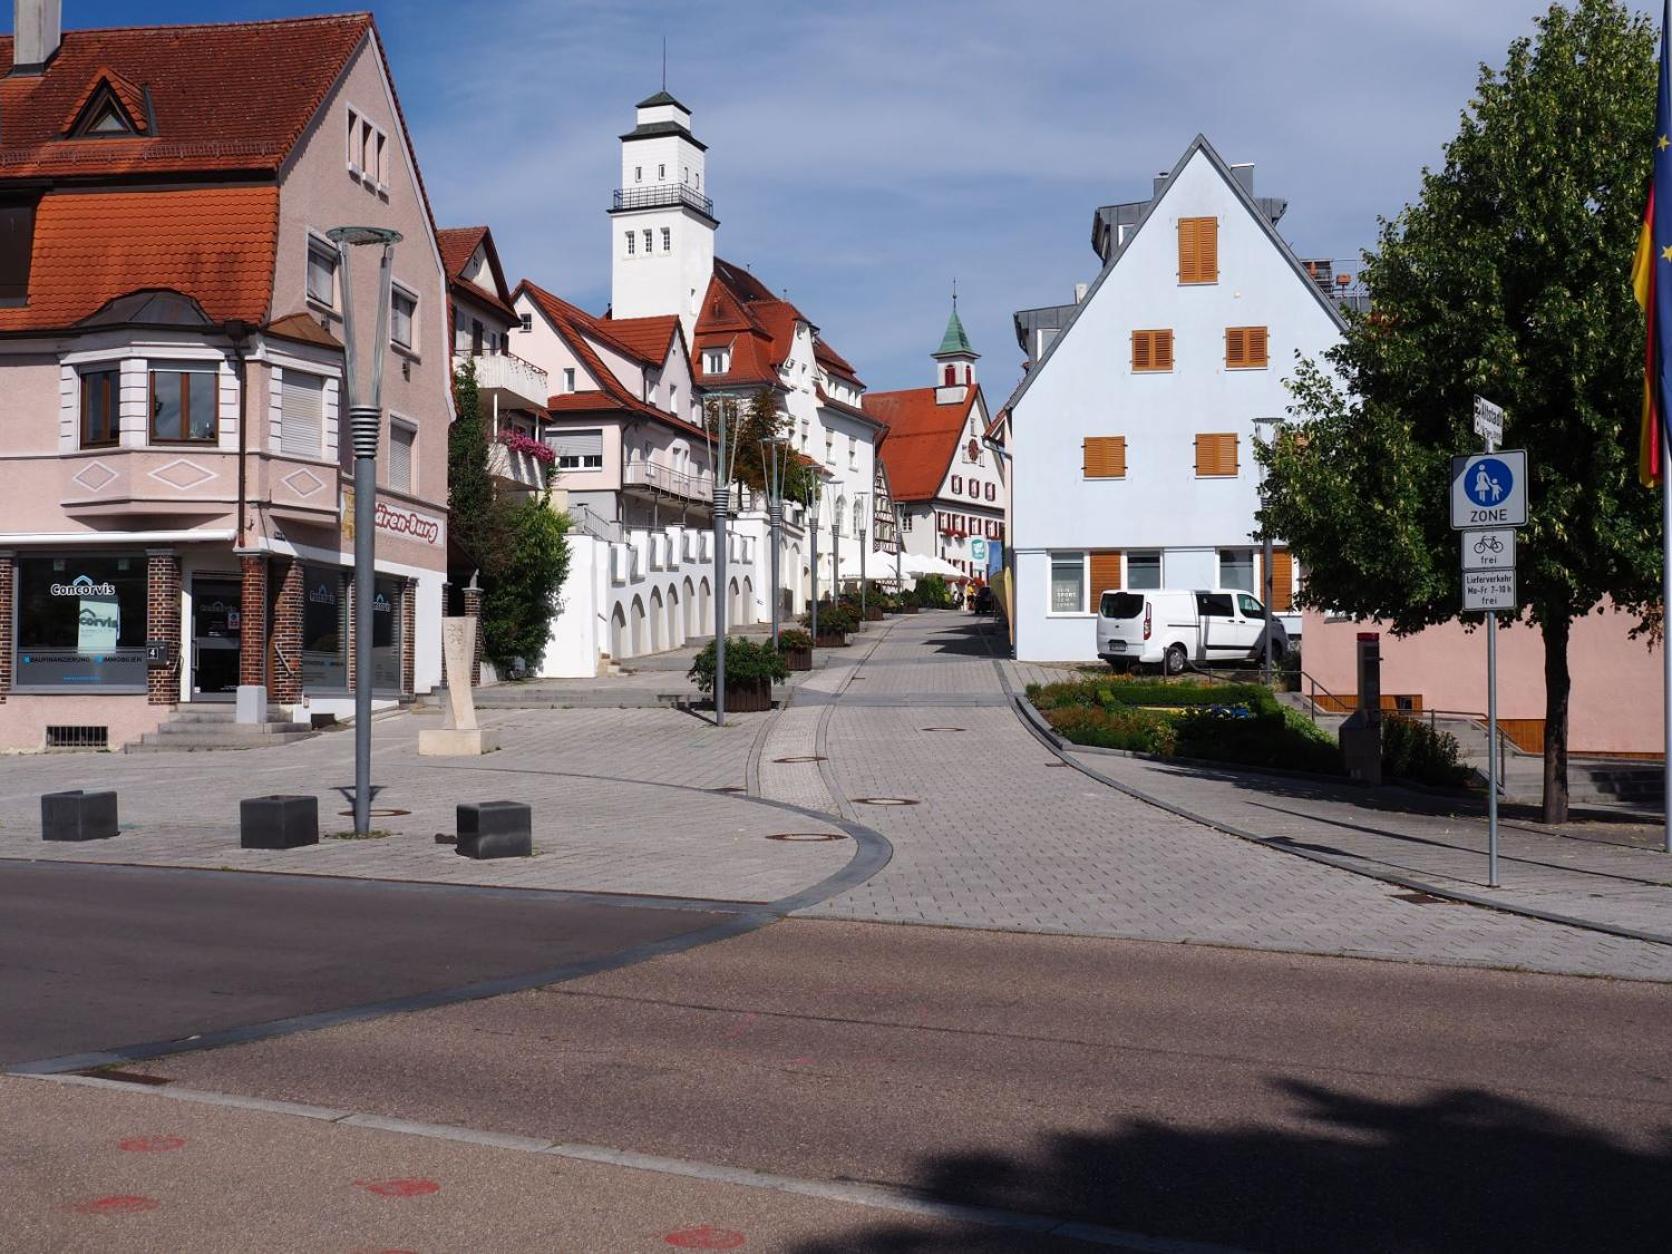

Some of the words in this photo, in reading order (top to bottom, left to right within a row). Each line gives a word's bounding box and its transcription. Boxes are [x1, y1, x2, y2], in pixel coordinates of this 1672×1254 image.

[1470, 508, 1508, 523] ZONE
[1480, 556, 1497, 564] frei
[1466, 574, 1512, 584] Lieferverkehr
[51, 583, 115, 596] Concorvis
[1482, 597, 1497, 605] frei
